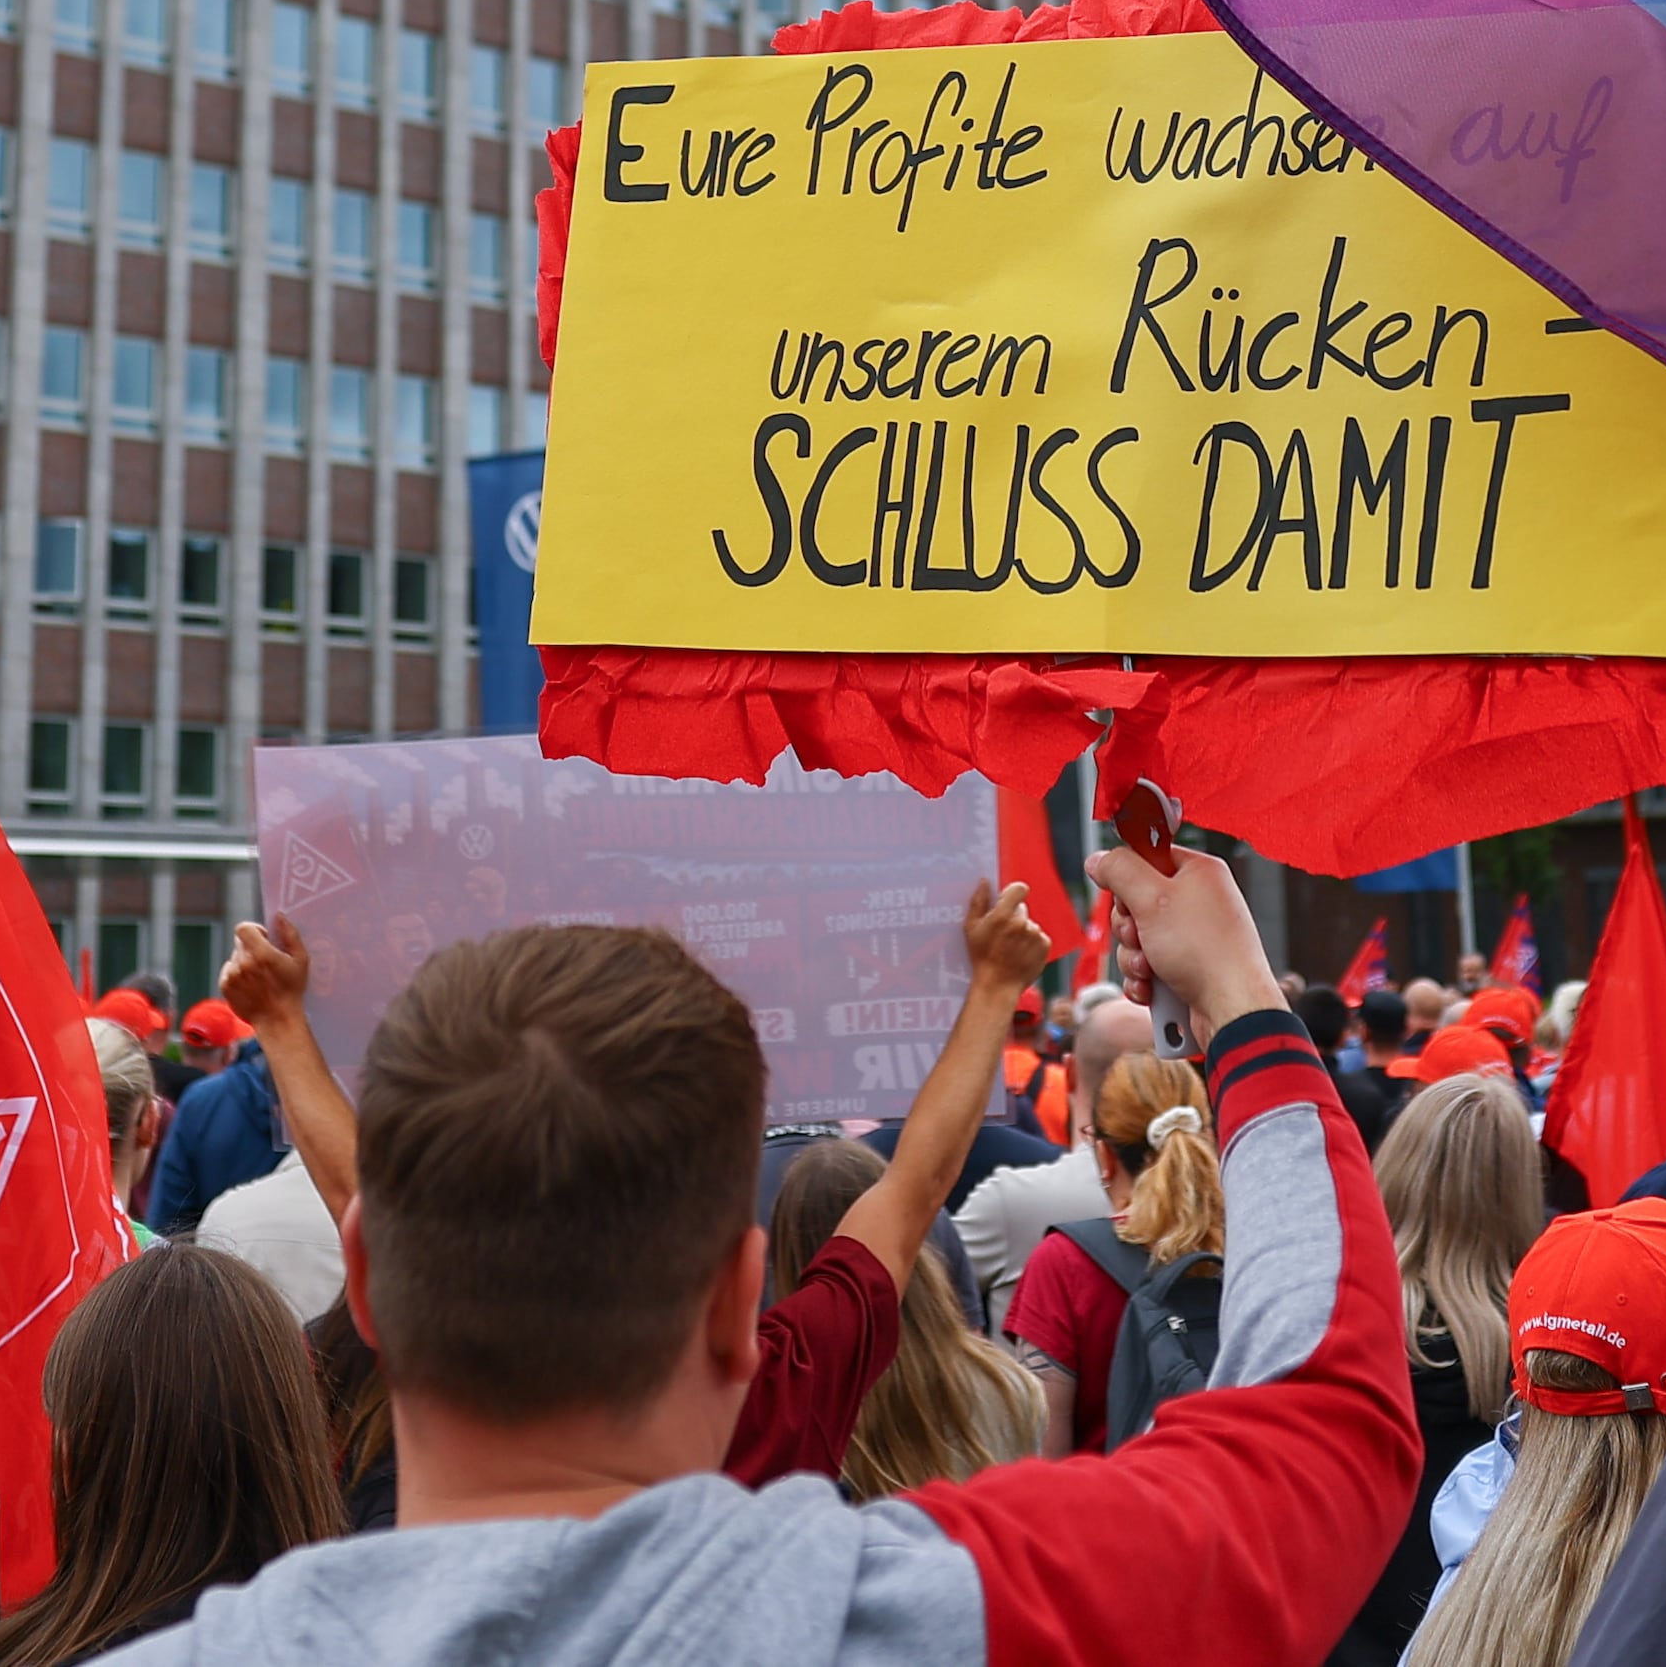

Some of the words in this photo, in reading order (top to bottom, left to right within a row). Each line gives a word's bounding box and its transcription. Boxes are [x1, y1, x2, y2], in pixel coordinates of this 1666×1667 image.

[603, 84, 777, 203] Eure
[805, 61, 1048, 233] Profite
[1450, 74, 1615, 203] auf
[770, 329, 1052, 405] unserem
[1109, 236, 1488, 394] Rücken
[711, 412, 1141, 595] SCHLUSS
[1188, 393, 1571, 593] DAMIT
